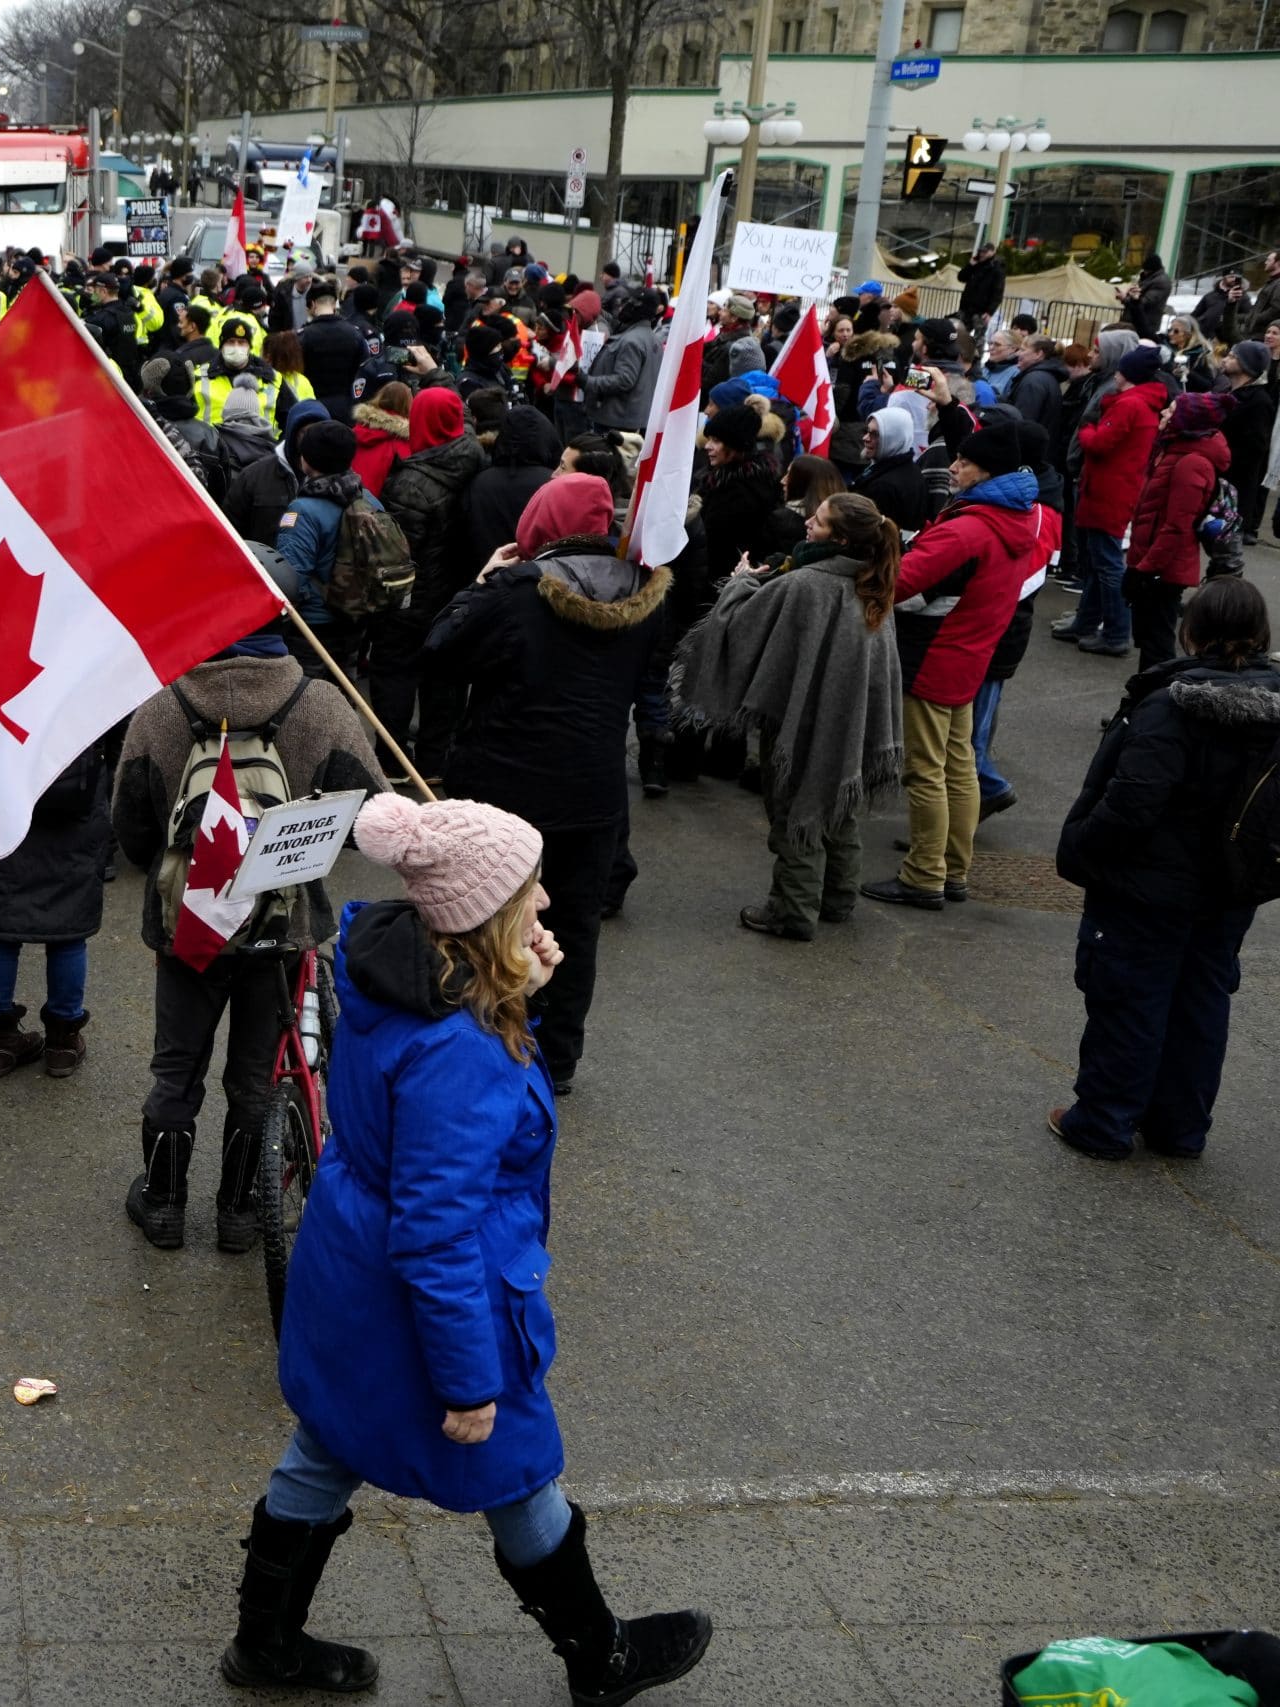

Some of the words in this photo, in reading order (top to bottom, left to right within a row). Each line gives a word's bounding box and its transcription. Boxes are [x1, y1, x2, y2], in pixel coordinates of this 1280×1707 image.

[131, 200, 161, 216] POLICE
[741, 225, 774, 250] YOU
[783, 234, 828, 257] HONK
[761, 253, 772, 264] IN
[779, 256, 809, 272] OUR
[276, 815, 337, 837] FRINGE
[259, 828, 340, 856] MINORITY
[275, 851, 305, 867] INC.
